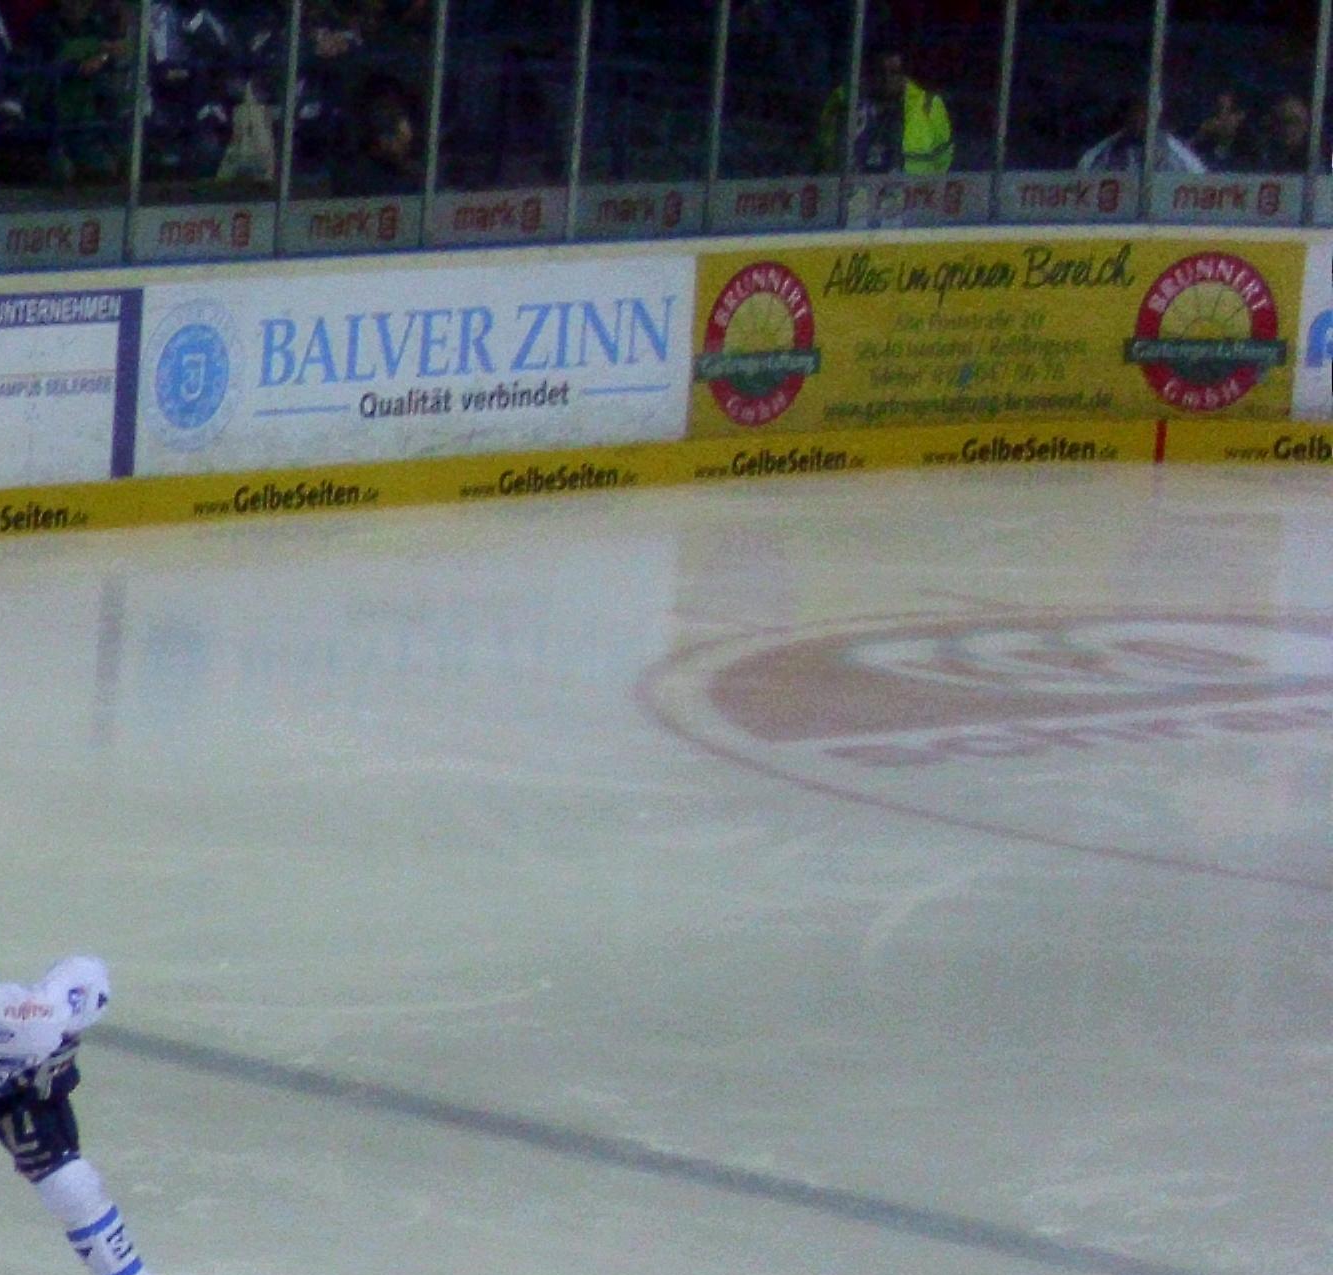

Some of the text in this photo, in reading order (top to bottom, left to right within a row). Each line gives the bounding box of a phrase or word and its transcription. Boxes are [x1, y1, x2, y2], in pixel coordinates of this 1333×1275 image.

[1018, 180, 1090, 208] mark
[1174, 184, 1246, 210] mark
[6, 224, 71, 255] mark
[159, 218, 221, 245] mark
[823, 248, 892, 298] Alles
[898, 261, 930, 293] im
[1022, 243, 1134, 290] Bereich
[257, 305, 497, 388] BALVER
[510, 294, 676, 371] ZINN
[358, 381, 570, 420] Qualität verbindet
